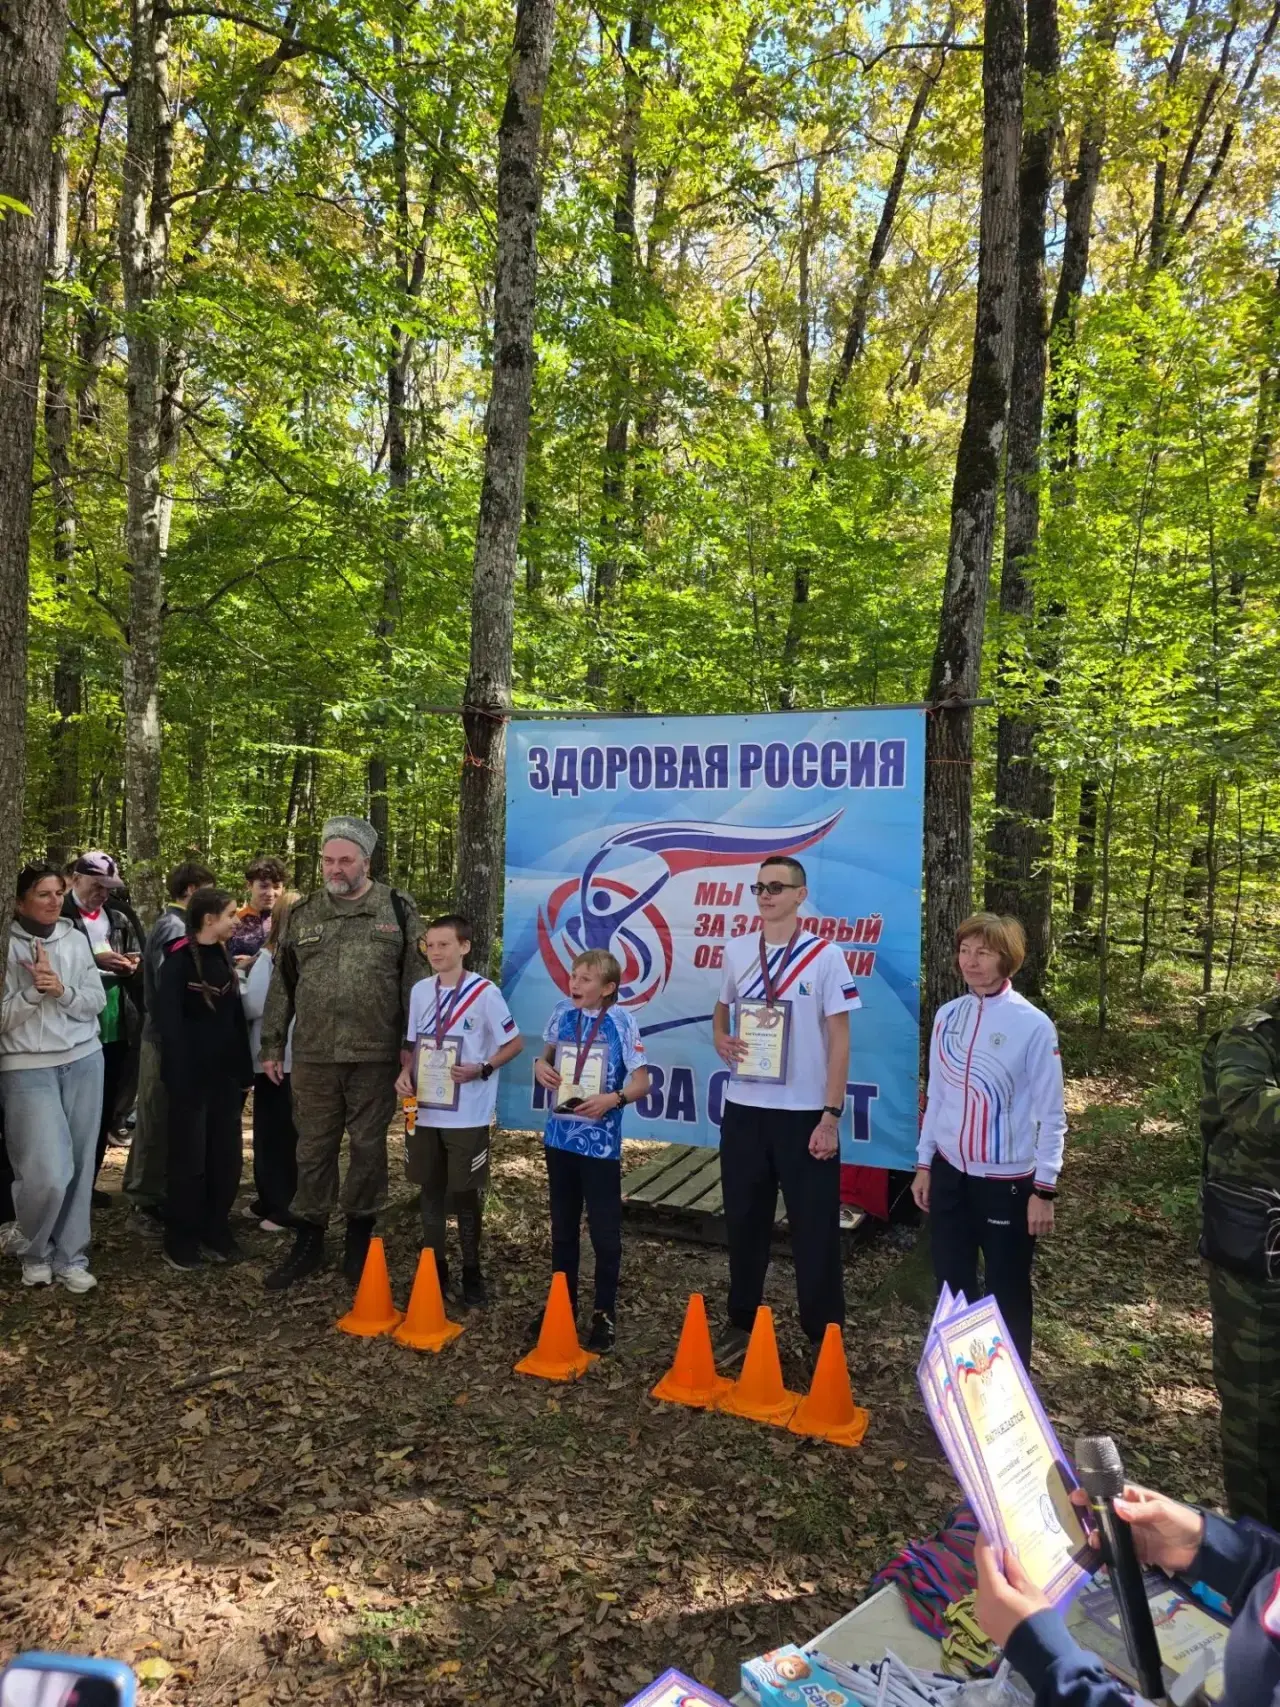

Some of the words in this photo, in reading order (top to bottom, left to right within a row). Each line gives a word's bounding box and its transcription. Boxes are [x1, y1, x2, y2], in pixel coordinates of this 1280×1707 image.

[528, 744, 729, 797] ЗДОРОВАЯ
[739, 740, 906, 790] РОССИЯ
[693, 881, 744, 907] МЫ
[693, 913, 726, 938] ЗА
[730, 911, 884, 944] ЗДОВЫЙ
[635, 1063, 698, 1123] ЗА
